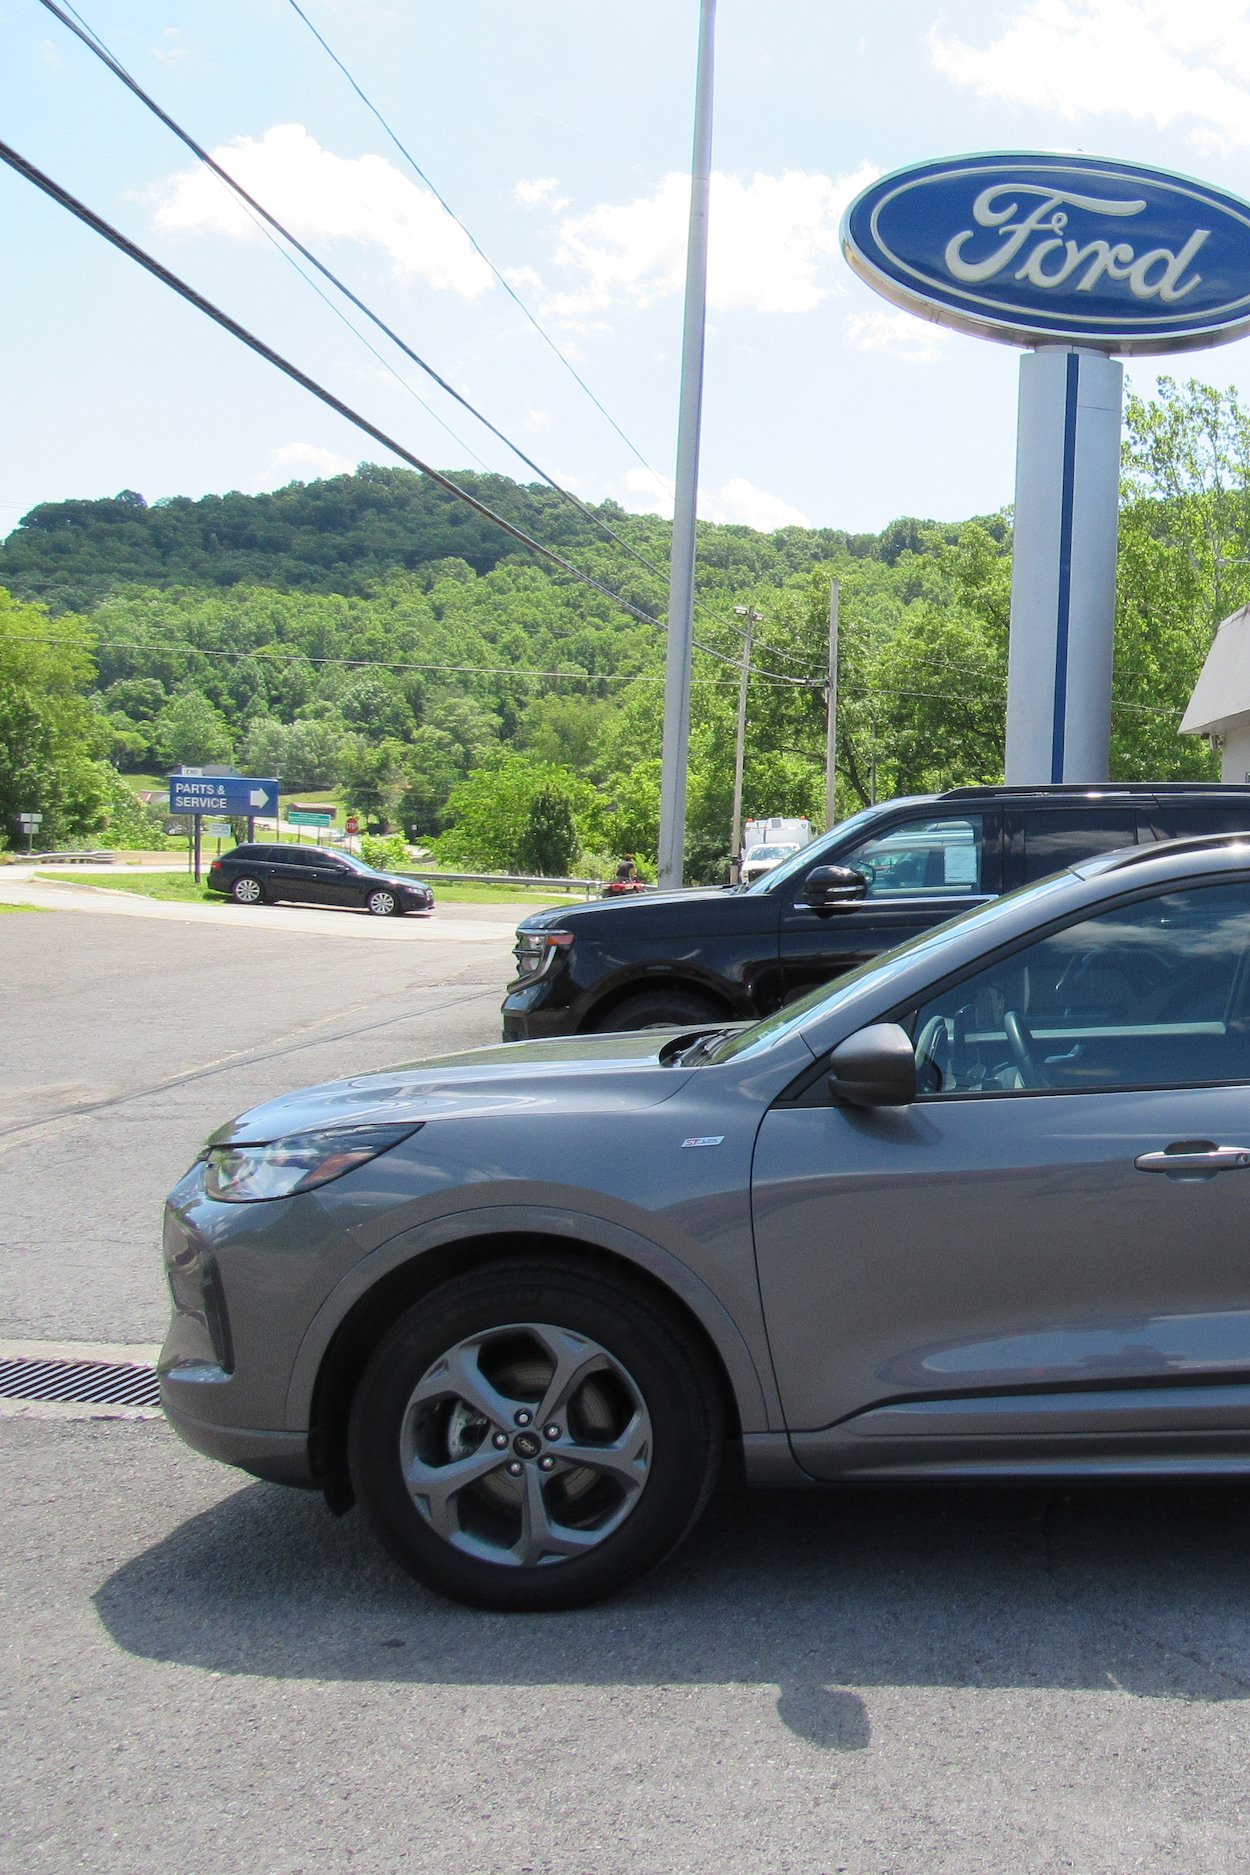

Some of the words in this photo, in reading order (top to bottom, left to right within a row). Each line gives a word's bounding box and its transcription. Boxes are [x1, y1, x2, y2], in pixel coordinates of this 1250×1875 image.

[944, 183, 1211, 301] Ford
[175, 783, 215, 795] PARTS
[217, 785, 226, 796] &
[175, 796, 228, 809] SERVICE
